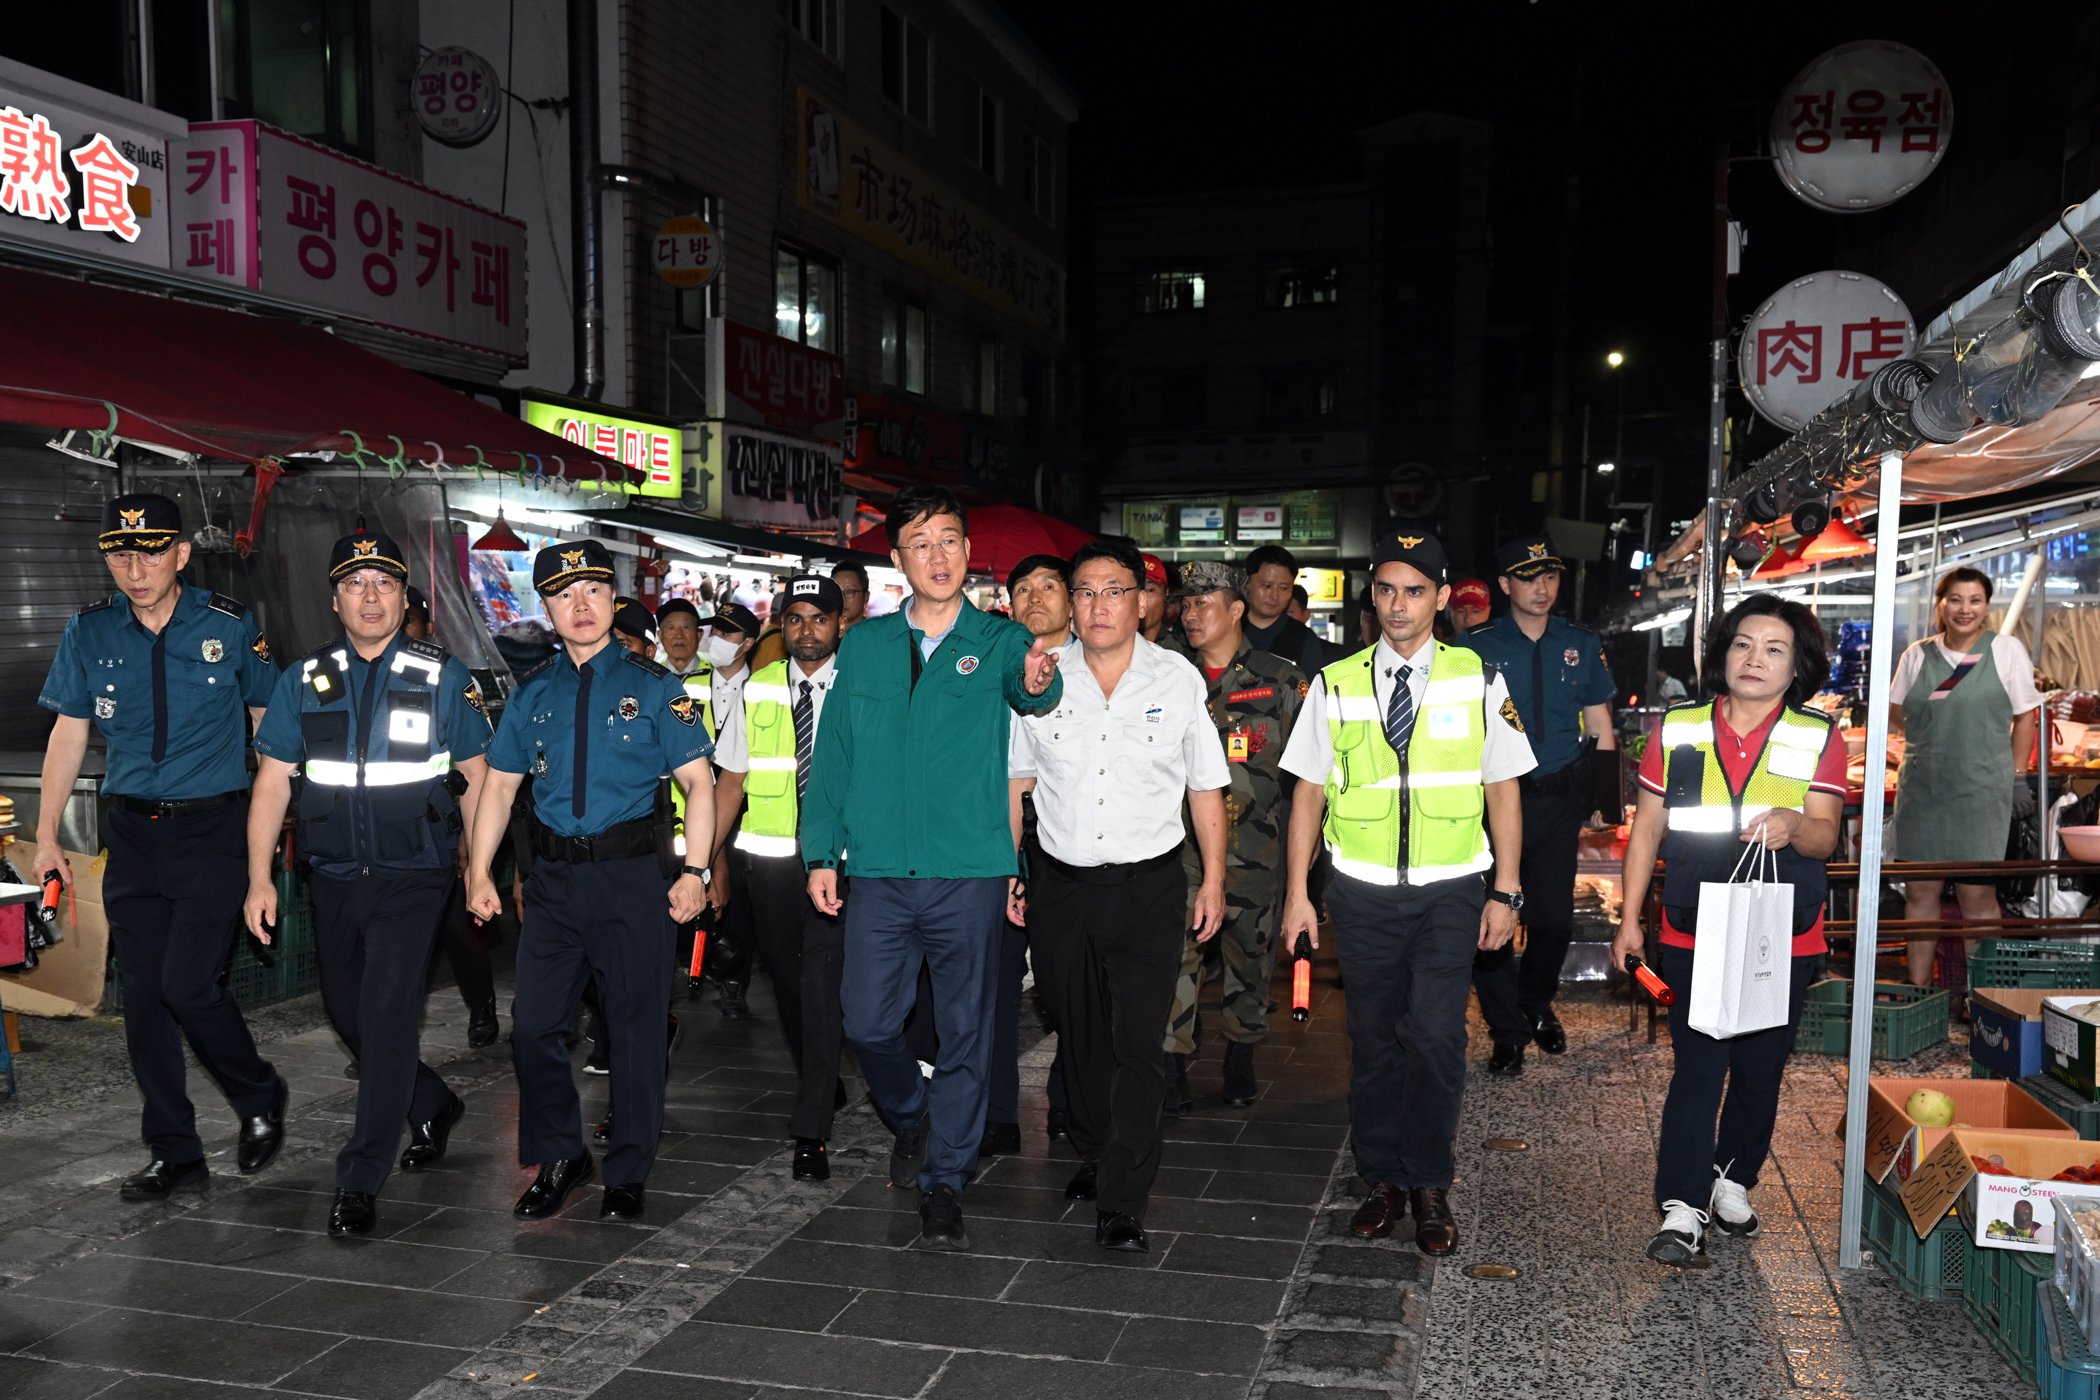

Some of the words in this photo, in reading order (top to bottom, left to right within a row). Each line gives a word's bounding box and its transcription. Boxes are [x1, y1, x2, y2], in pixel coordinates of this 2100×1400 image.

[418, 69, 483, 115] 평양
[1790, 88, 1943, 154] 정육점
[0, 106, 141, 243] 熟食
[121, 140, 165, 171] 安山店
[185, 146, 237, 275] 카페
[851, 146, 1039, 312] 市场麻将游戏厅
[286, 173, 511, 327] 평양카페
[658, 236, 711, 267] 다방
[738, 335, 833, 418] 진실다방
[1757, 317, 1906, 386] 肉店
[729, 434, 833, 521] 진실다방
[1132, 513, 1164, 523] TANK
